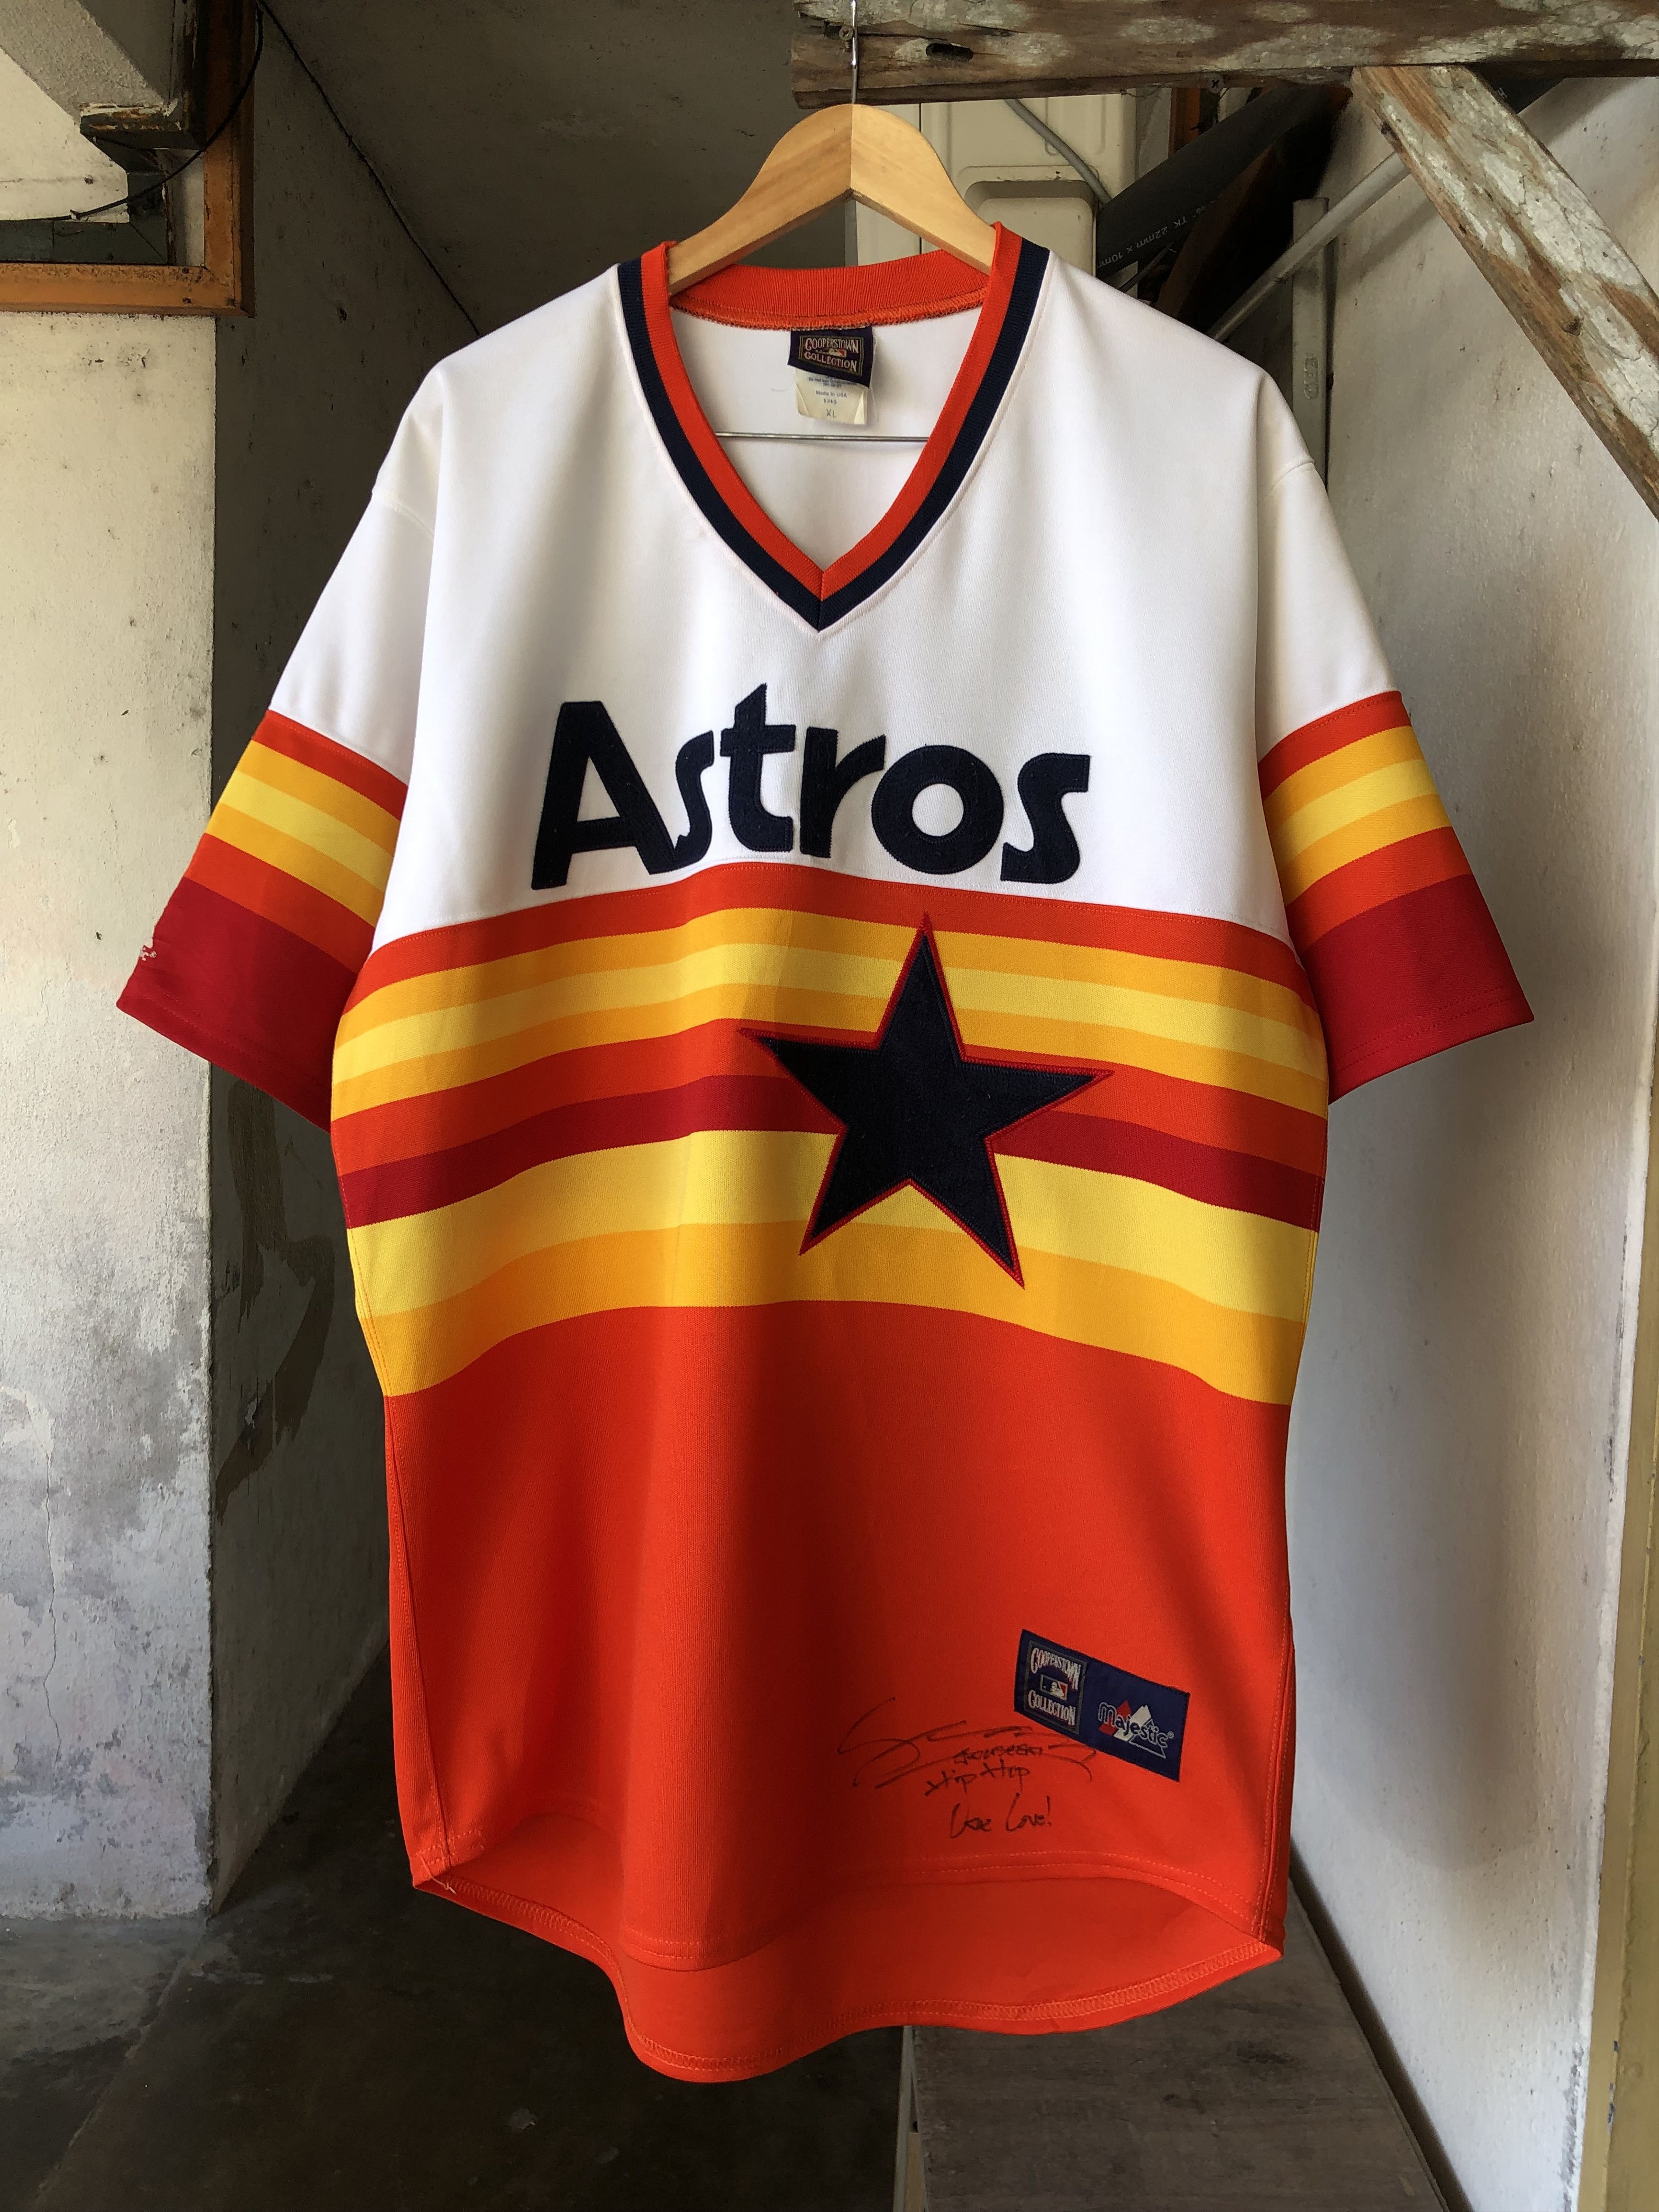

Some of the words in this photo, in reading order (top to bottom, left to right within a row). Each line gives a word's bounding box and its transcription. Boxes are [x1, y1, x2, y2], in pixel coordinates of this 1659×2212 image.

[805, 337, 858, 353] COOPERSTOWN
[804, 351, 857, 373] COLLECTION
[826, 409, 837, 418] XL
[531, 683, 1091, 891] Astros
[1030, 1647, 1081, 1690] COOPERSTOWN
[1027, 1690, 1076, 1726] COLLECTION
